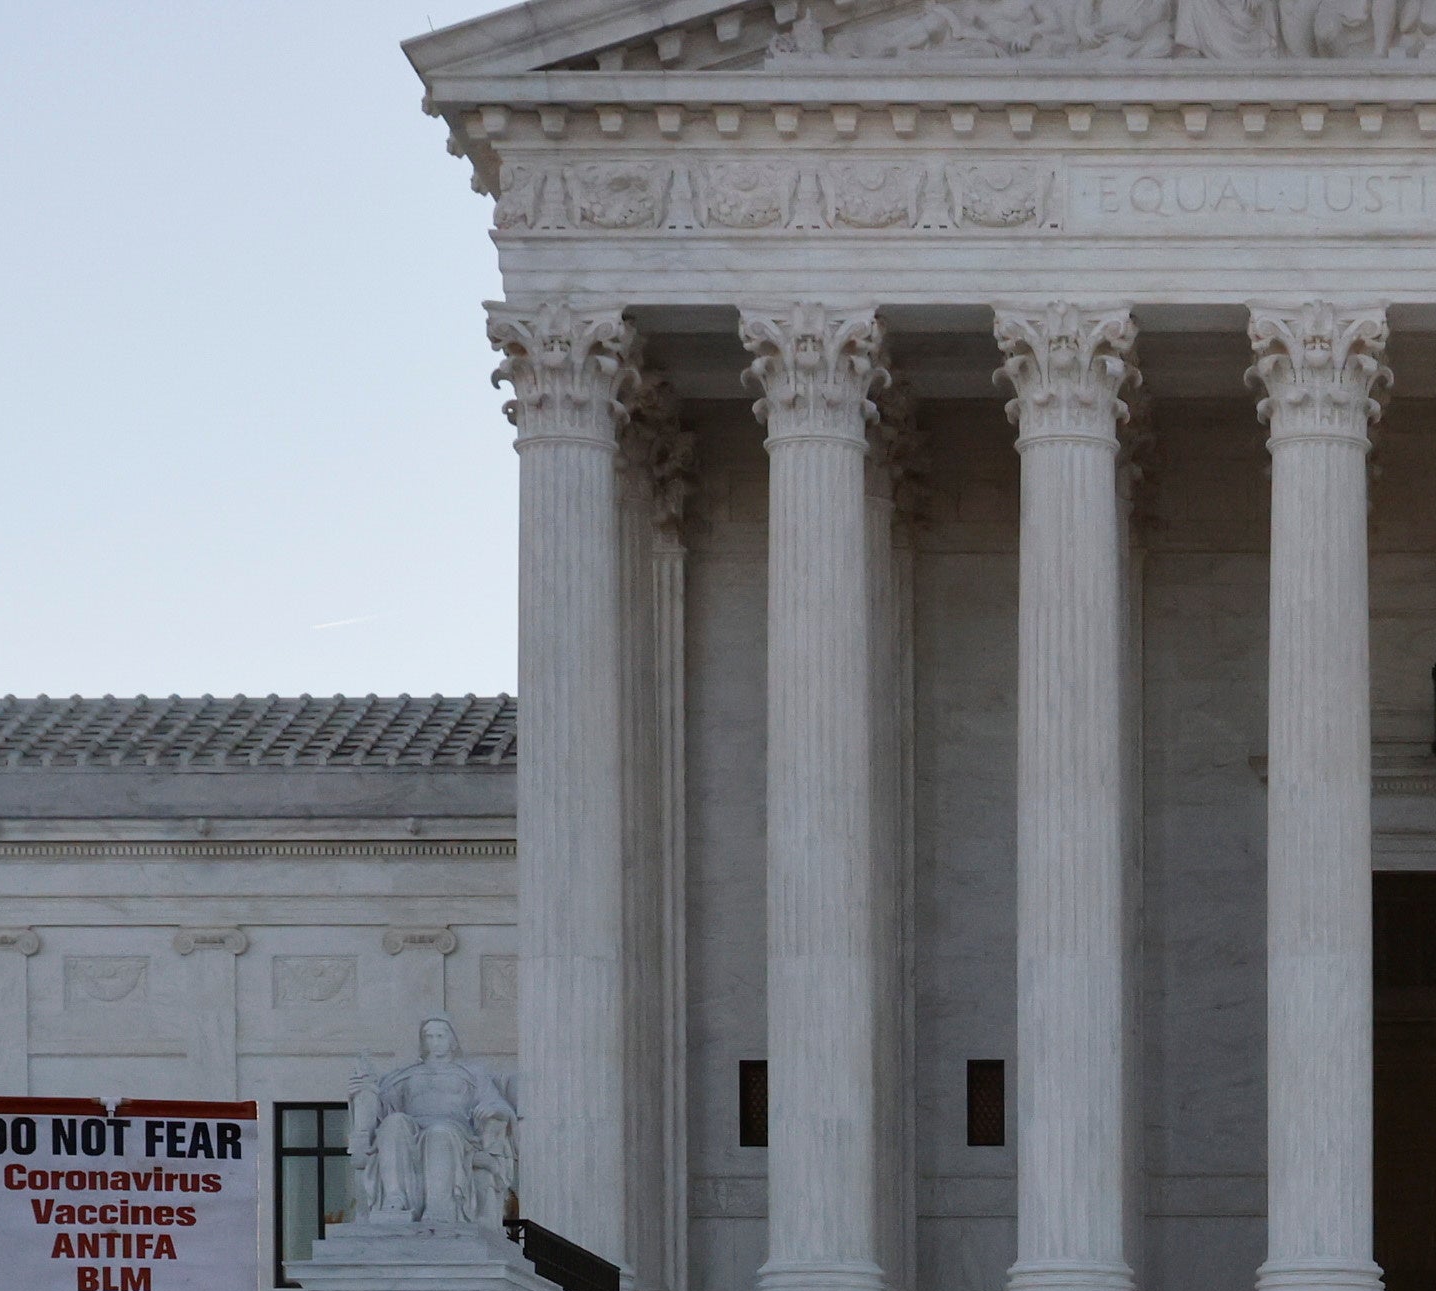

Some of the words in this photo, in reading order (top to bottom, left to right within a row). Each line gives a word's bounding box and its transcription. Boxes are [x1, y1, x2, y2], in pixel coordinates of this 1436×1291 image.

[1099, 175, 1274, 218] EQUAL
[52, 1118, 130, 1156] NOT
[145, 1120, 242, 1159] FEAR
[4, 1164, 222, 1192] Coronavirus
[31, 1199, 196, 1226] Vaccines
[51, 1232, 177, 1260] ANTIFA
[77, 1266, 151, 1291] BLM
